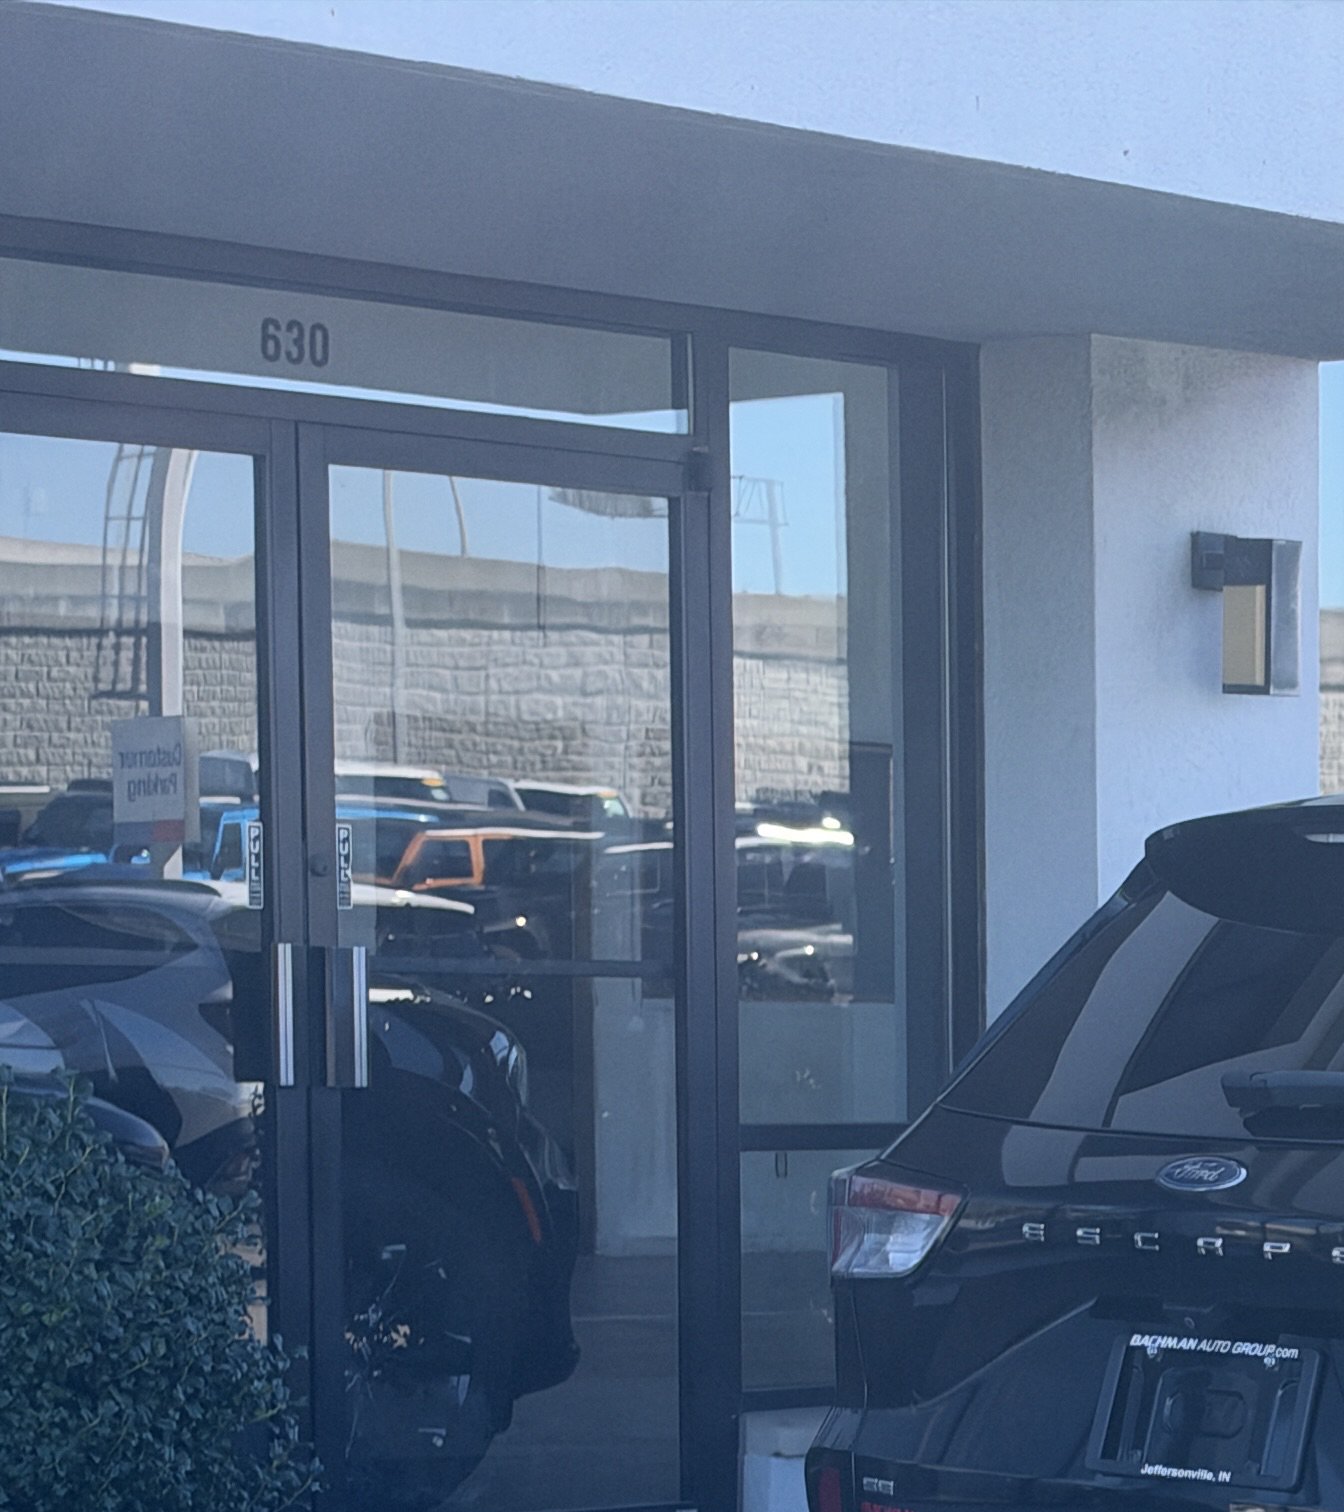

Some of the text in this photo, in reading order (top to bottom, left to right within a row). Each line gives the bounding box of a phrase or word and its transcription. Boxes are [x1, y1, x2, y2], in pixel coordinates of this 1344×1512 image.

[261, 317, 329, 367] 630
[250, 827, 260, 881] PULL
[339, 828, 350, 881] PULL
[1174, 1162, 1226, 1182] Ford
[1129, 1333, 1299, 1359] BACHMAN AUTO GROUP.com
[1140, 1463, 1232, 1483] Jeffersonville, IN
